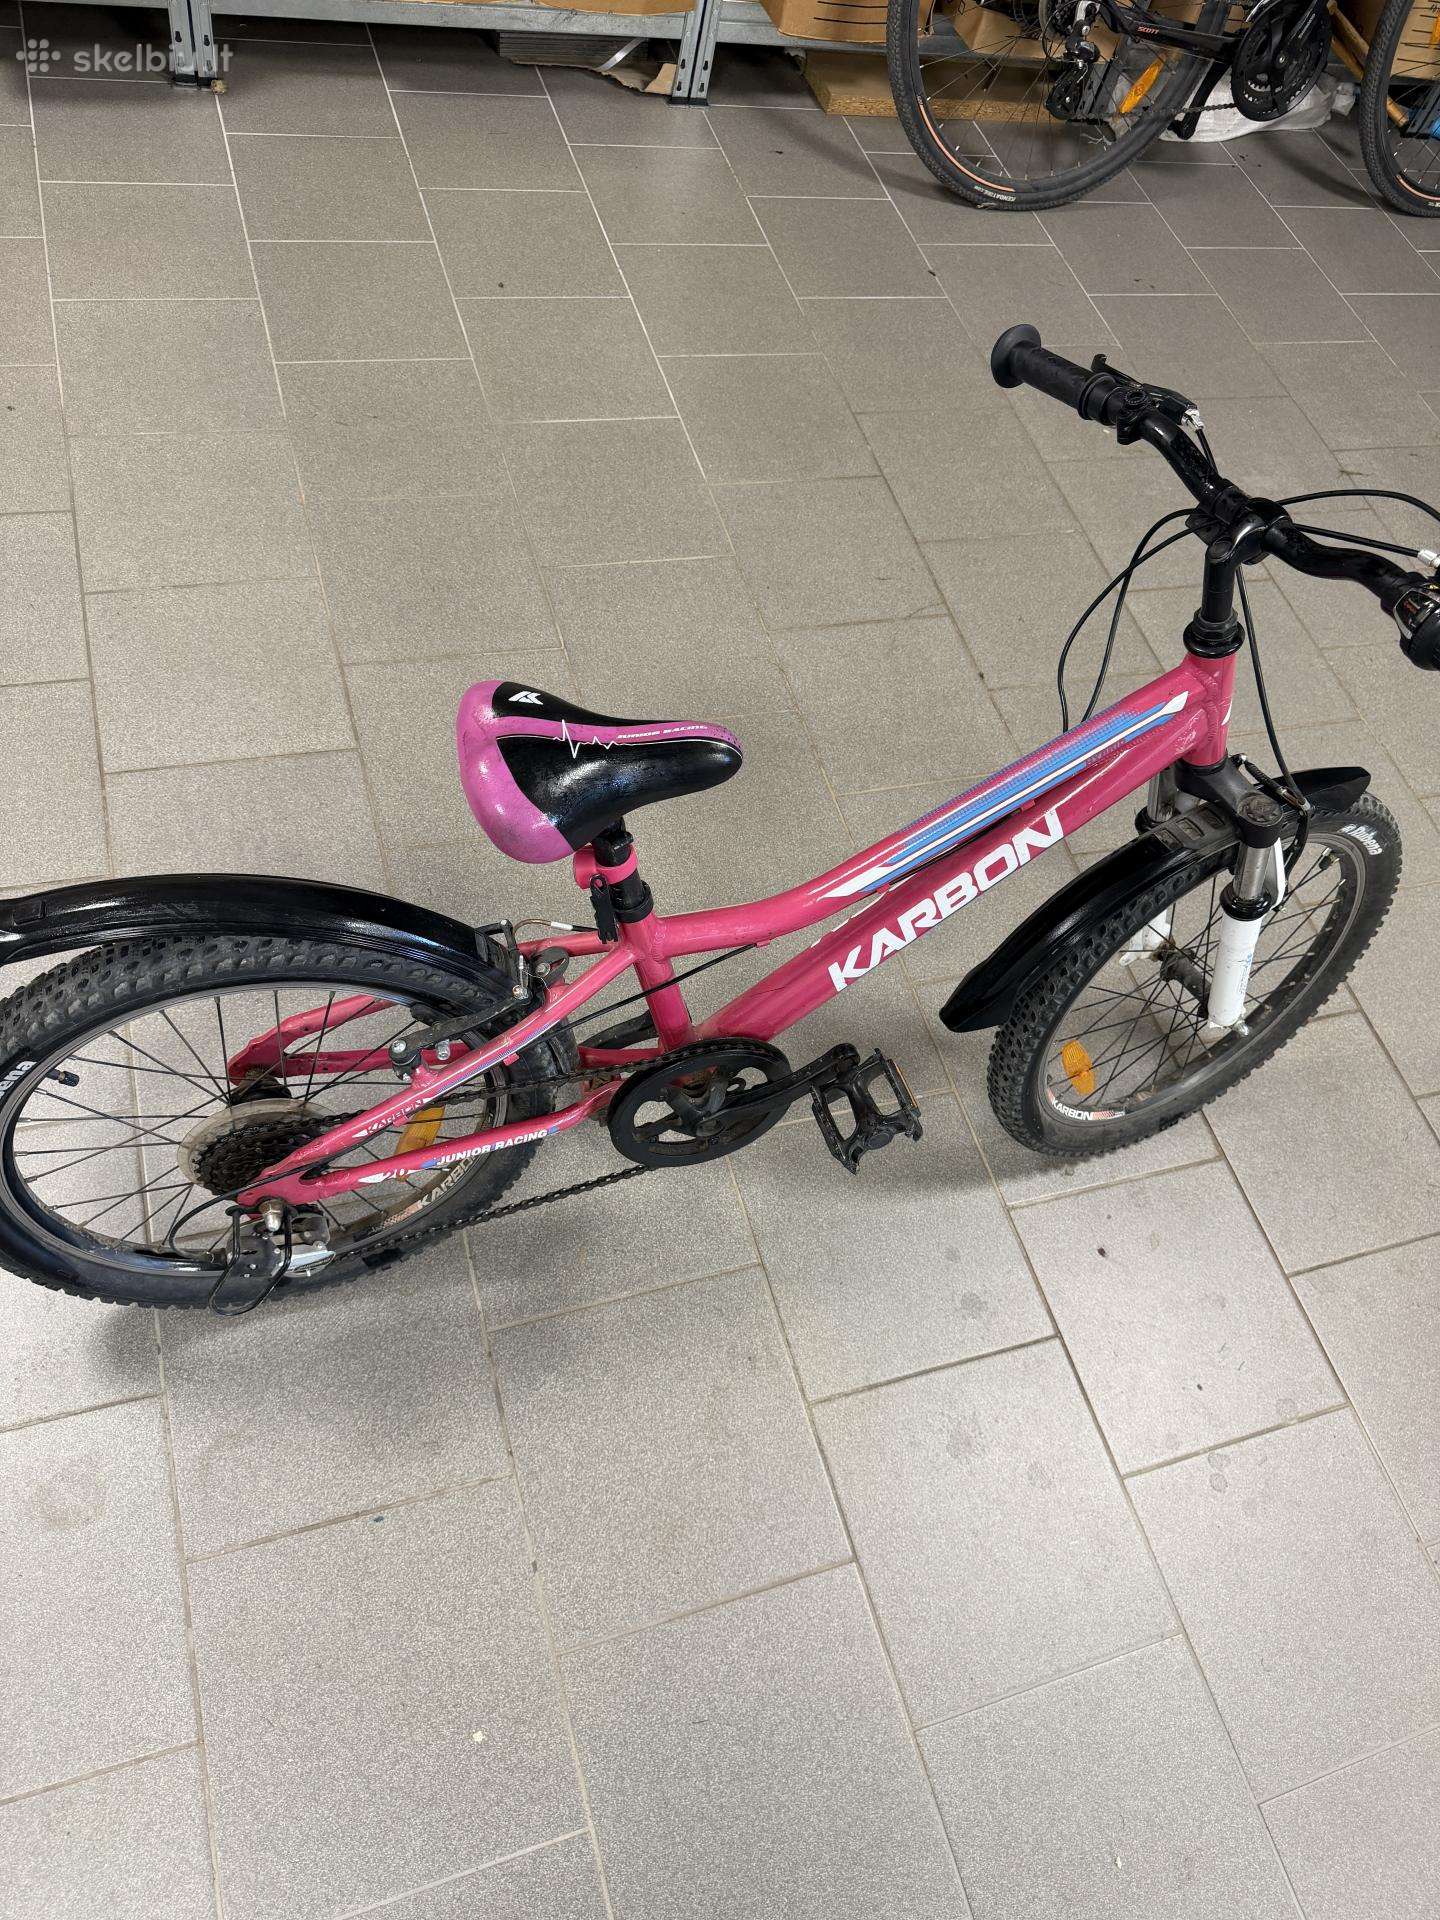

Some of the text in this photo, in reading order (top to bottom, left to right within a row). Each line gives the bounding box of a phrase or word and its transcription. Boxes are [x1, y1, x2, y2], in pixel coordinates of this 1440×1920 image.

[1137, 26, 1160, 34] SCOTT
[827, 807, 1065, 992] KARBON
[1051, 1097, 1094, 1121] KARBON
[436, 1128, 548, 1166] JUNIOR RACING
[418, 1153, 478, 1208] KARBO
